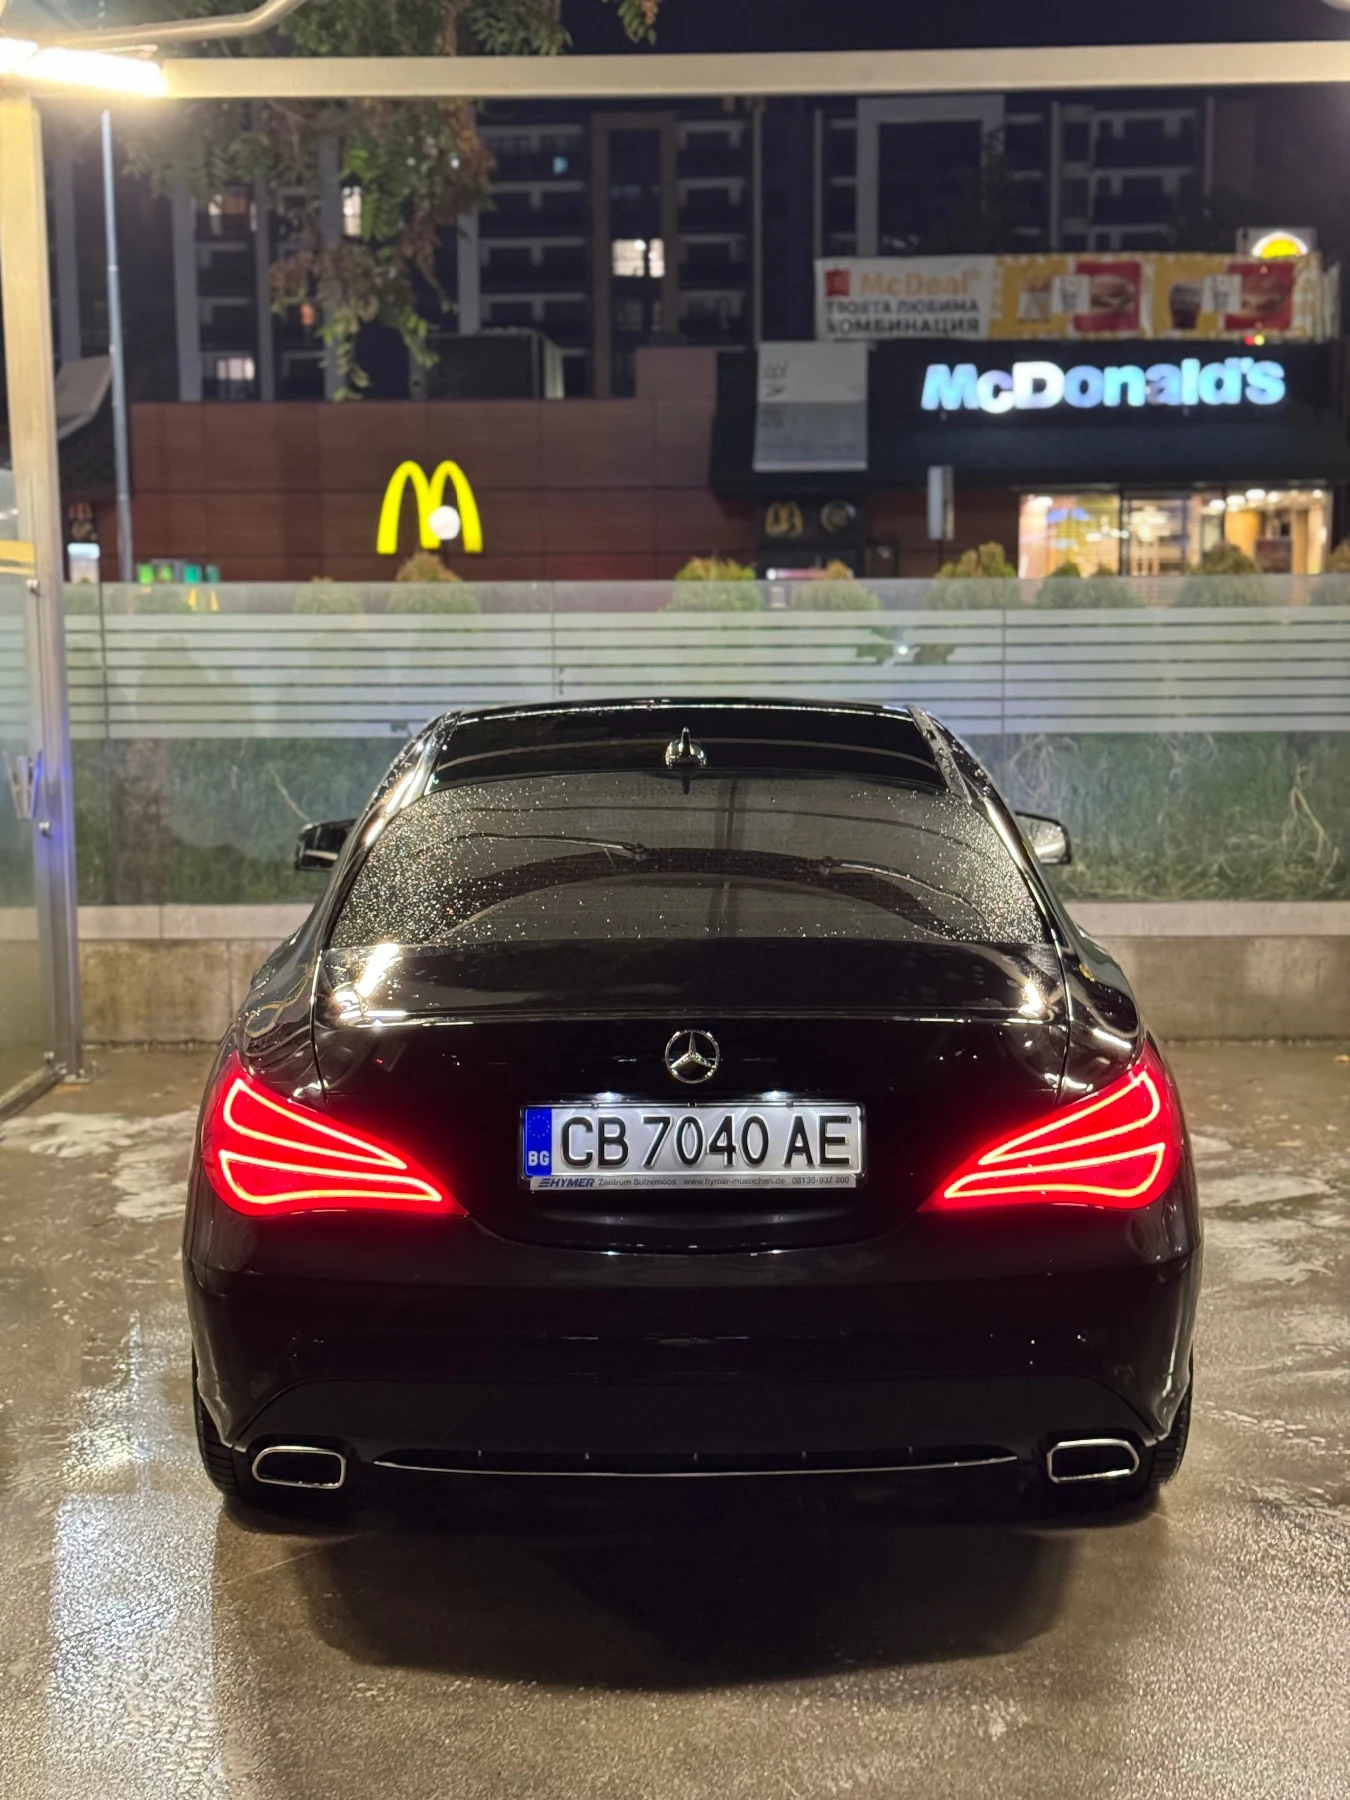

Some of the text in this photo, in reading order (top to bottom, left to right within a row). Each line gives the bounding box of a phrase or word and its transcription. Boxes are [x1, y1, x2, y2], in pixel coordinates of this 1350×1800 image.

[921, 357, 1286, 414] McDonald's
[561, 1115, 852, 1167] CB 7040 AE
[528, 1151, 550, 1167] BG
[550, 1178, 595, 1187] HYMER
[598, 1178, 631, 1186] Zentrum
[835, 1176, 850, 1184] 200
